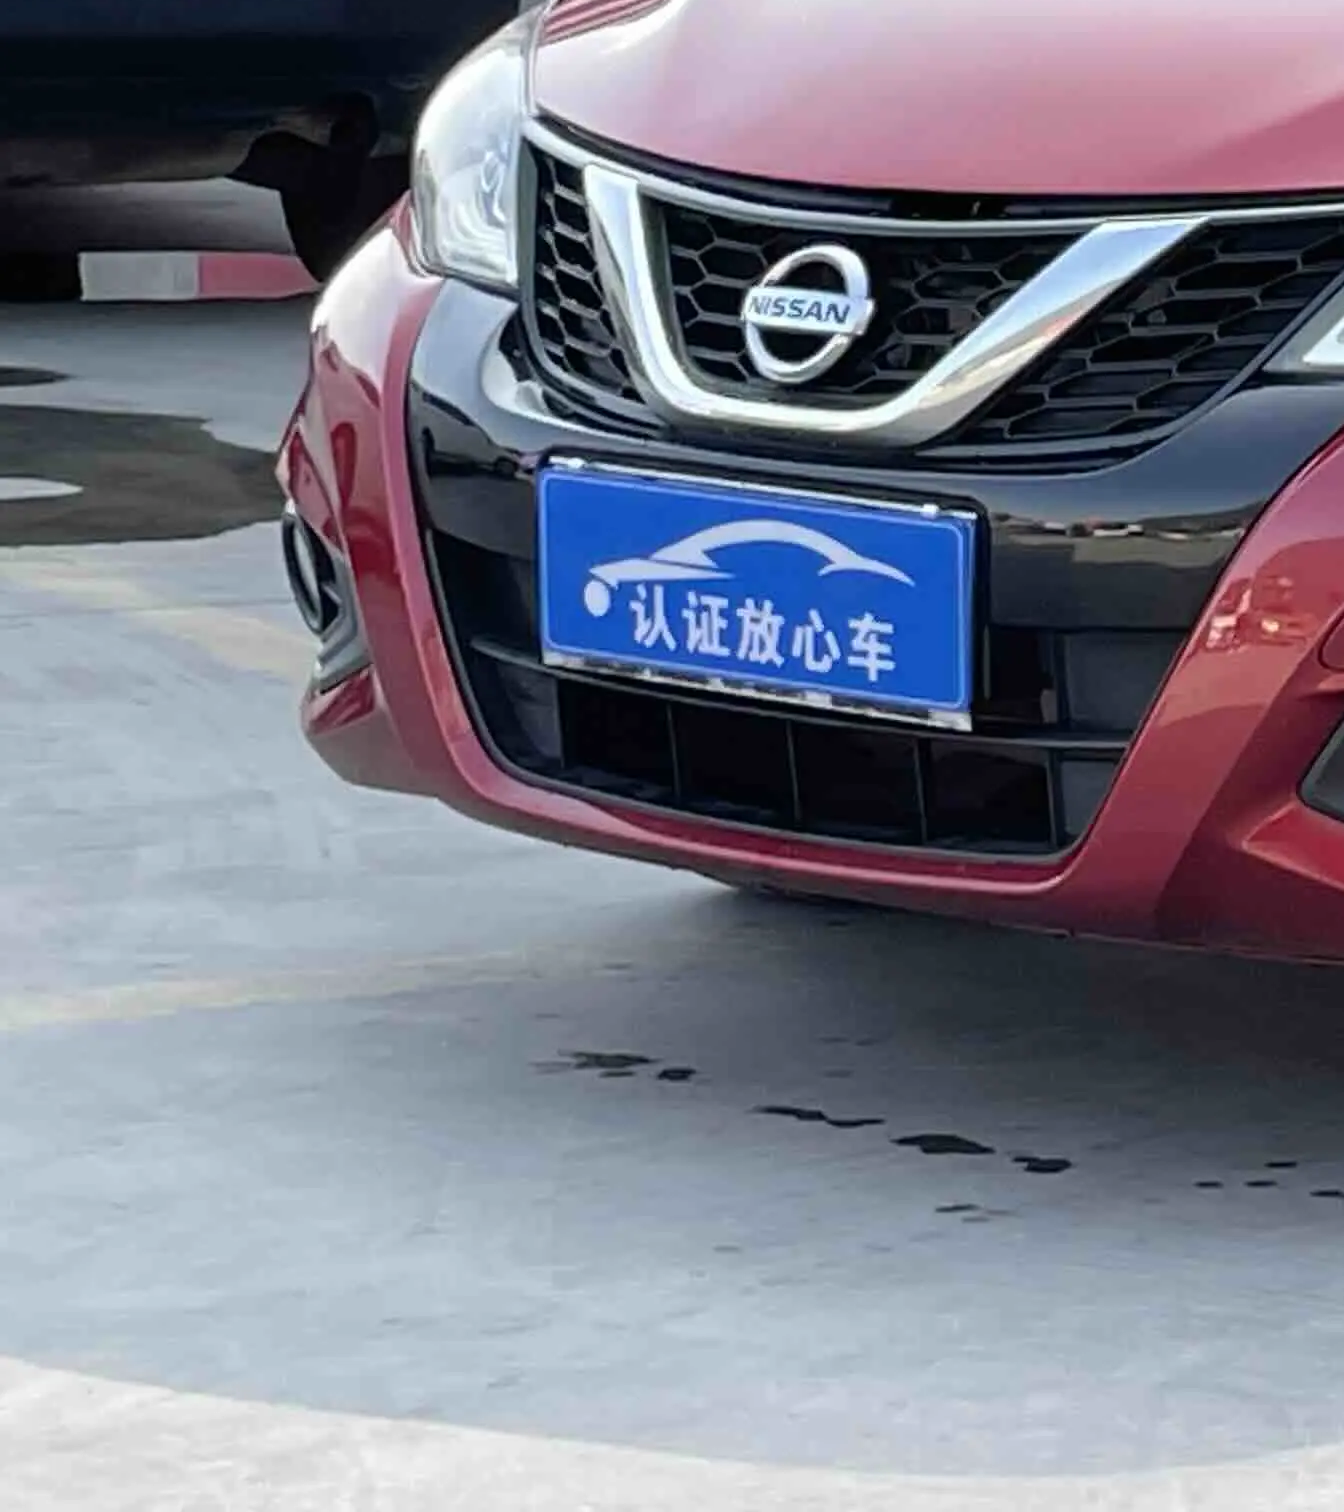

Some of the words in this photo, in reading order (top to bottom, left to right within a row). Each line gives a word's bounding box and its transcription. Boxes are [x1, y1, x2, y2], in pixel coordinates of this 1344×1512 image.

[749, 295, 851, 325] NISSAN
[629, 583, 896, 682] 认证放心车
